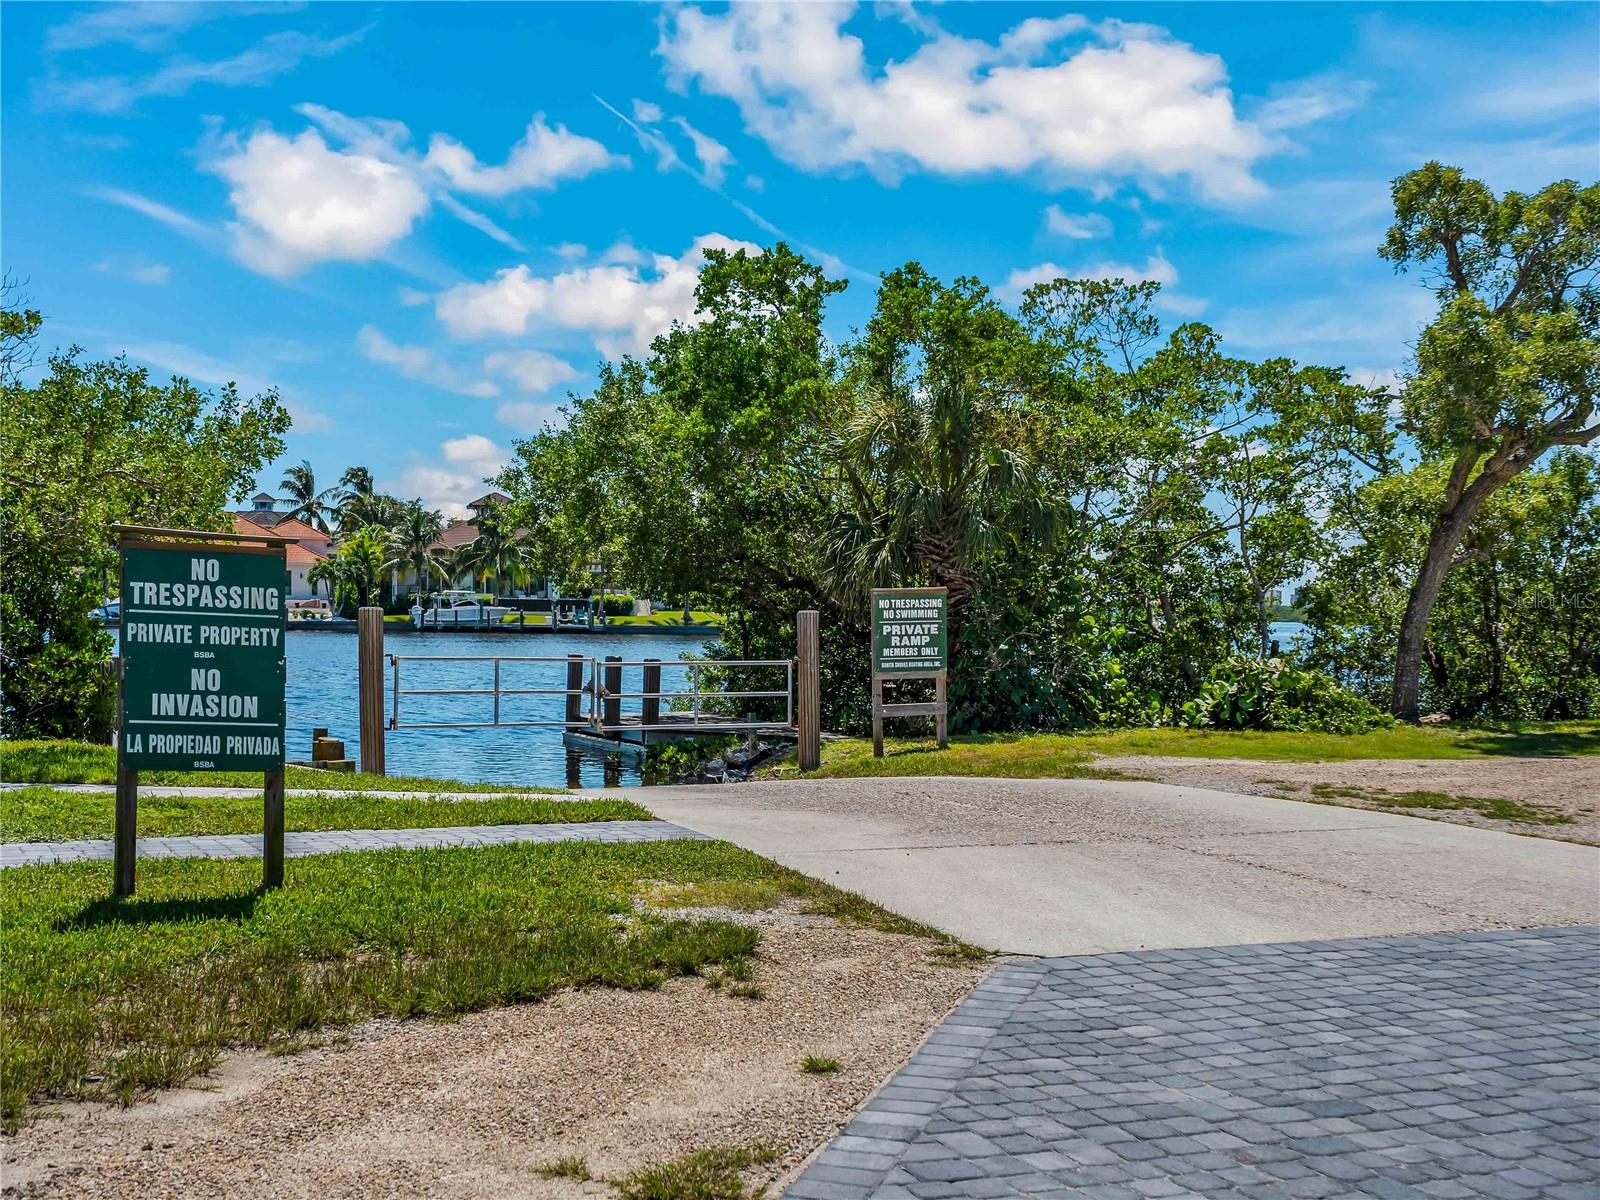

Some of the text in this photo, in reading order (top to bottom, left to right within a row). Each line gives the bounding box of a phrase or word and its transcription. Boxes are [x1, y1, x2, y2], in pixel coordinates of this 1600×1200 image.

[191, 558, 220, 582] NO
[130, 582, 279, 610] TRESPASSING
[879, 599, 942, 608] NO TRESPASSING
[883, 609, 938, 618] NO SWIMMING
[128, 623, 280, 647] PRIVATE PROPERTY
[883, 625, 938, 635] PRIVATE
[892, 636, 930, 646] RAMP
[194, 651, 215, 659] BSBA
[883, 647, 938, 656] MEMBERS ONLY
[191, 669, 221, 691] NO
[152, 693, 258, 718] INVASION
[127, 734, 280, 755] LA PROPIEDAD PRIVADA
